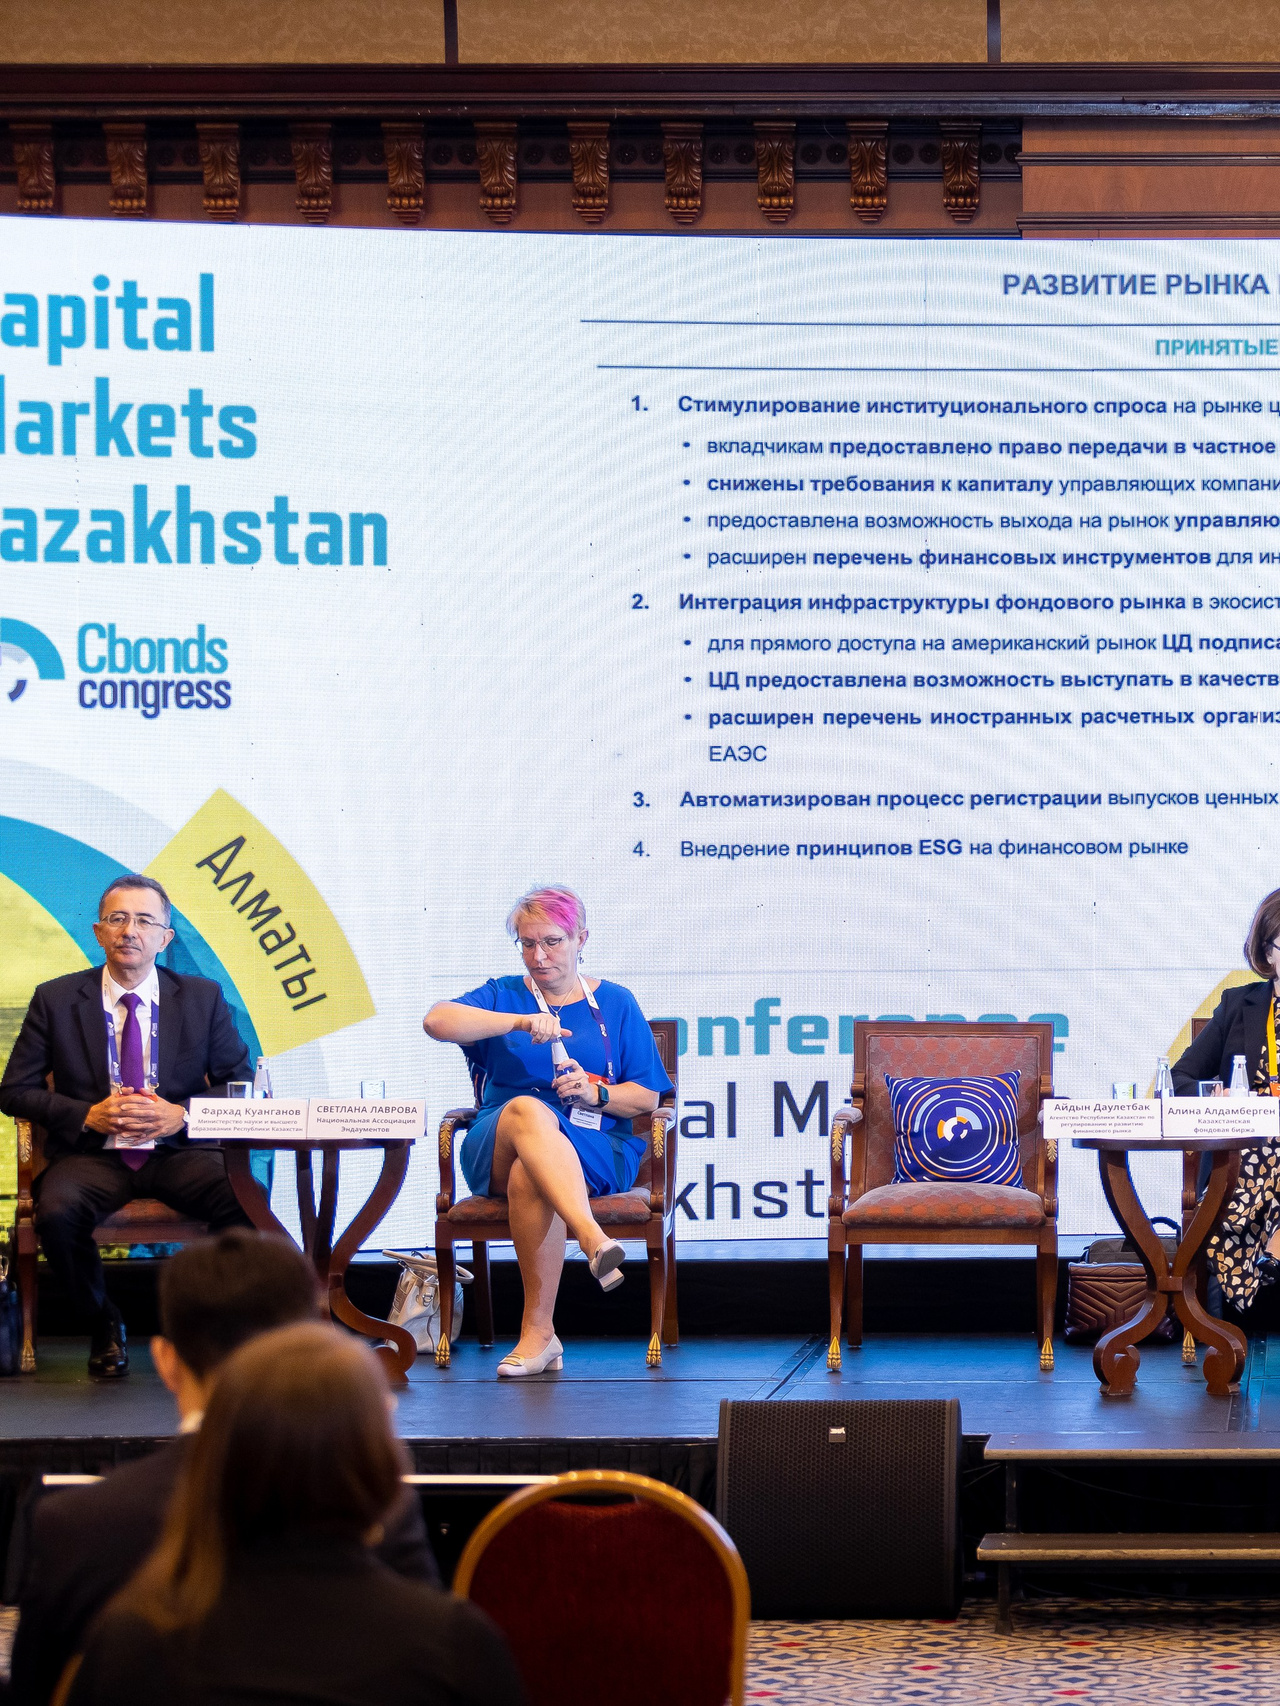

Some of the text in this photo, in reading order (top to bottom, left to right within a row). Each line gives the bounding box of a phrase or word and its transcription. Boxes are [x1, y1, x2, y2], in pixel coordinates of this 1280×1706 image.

[1002, 273, 1157, 296] РАЗВИТИЕ
[1165, 273, 1271, 295] РЫНКА
[0, 273, 214, 366] apital
[1154, 338, 1279, 357] ПРИНЯТЫЕ
[0, 374, 257, 459] arkets
[631, 394, 649, 412] 1.
[678, 395, 861, 417] Стимулирование
[866, 400, 1089, 418] институционального
[1093, 400, 1168, 418] спроса
[1173, 400, 1196, 414] на
[1203, 400, 1263, 418] рынке
[707, 440, 823, 457] вкладчикам
[829, 441, 993, 459] предоставлено
[998, 442, 1063, 459] право
[1068, 441, 1168, 459] передачи
[1173, 442, 1187, 454] в
[1192, 441, 1276, 455] частное
[706, 478, 804, 492] снижены
[809, 474, 935, 496] требования
[941, 478, 952, 492] к
[957, 478, 1054, 496] капиталу
[1058, 478, 1196, 496] управляющих
[0, 484, 388, 567] azakhstan
[707, 515, 859, 532] предоставлена
[864, 515, 994, 529] возможность
[1000, 515, 1073, 531] выхода
[1079, 515, 1102, 529] на
[1108, 515, 1169, 532] рынок
[708, 552, 807, 569] расширен
[812, 552, 913, 570] перечень
[918, 548, 1057, 570] финансовых
[1062, 552, 1212, 570] инструментов
[1215, 552, 1253, 567] для
[631, 593, 650, 610] 2.
[679, 593, 802, 614] Интеграция
[807, 593, 989, 615] инфраструктуры
[995, 593, 1115, 614] фондового
[1119, 596, 1186, 614] рынка
[1192, 597, 1204, 610] в
[77, 622, 229, 674] Cbonds
[707, 638, 745, 654] для
[750, 638, 832, 655] прямого
[836, 638, 916, 656] доступа
[922, 638, 946, 651] на
[951, 634, 1090, 655] американский
[1096, 637, 1157, 655] рынок
[1162, 633, 1193, 654] ЦД
[708, 671, 740, 691] ЦД
[745, 674, 907, 692] предоставлена
[913, 674, 1055, 688] возможность
[1060, 674, 1174, 692] выступать
[1180, 674, 1193, 687] в
[78, 680, 232, 720] congress
[708, 712, 814, 730] расширен
[822, 712, 922, 729] перечень
[930, 711, 1073, 729] иностранных
[1081, 711, 1195, 729] расчетных
[709, 745, 767, 763] ЕАЭС
[632, 791, 651, 808] 3.
[679, 790, 871, 811] Автоматизирован
[876, 793, 964, 811] процесс
[970, 793, 1102, 811] регистрации
[1108, 792, 1200, 810] выпусков
[1205, 792, 1279, 809] ценных
[632, 838, 1189, 861] 4. Внедрение принципов ESG на финансовом рынке
[195, 835, 328, 1012] Алматы
[201, 1107, 301, 1117] Фархад Куанганов
[316, 1105, 418, 1114] СВЕТЛАНА ЛАВРОВА
[1054, 1102, 1150, 1113] Айдын Даулетбак
[1167, 1107, 1276, 1117] Алина Алдамберген
